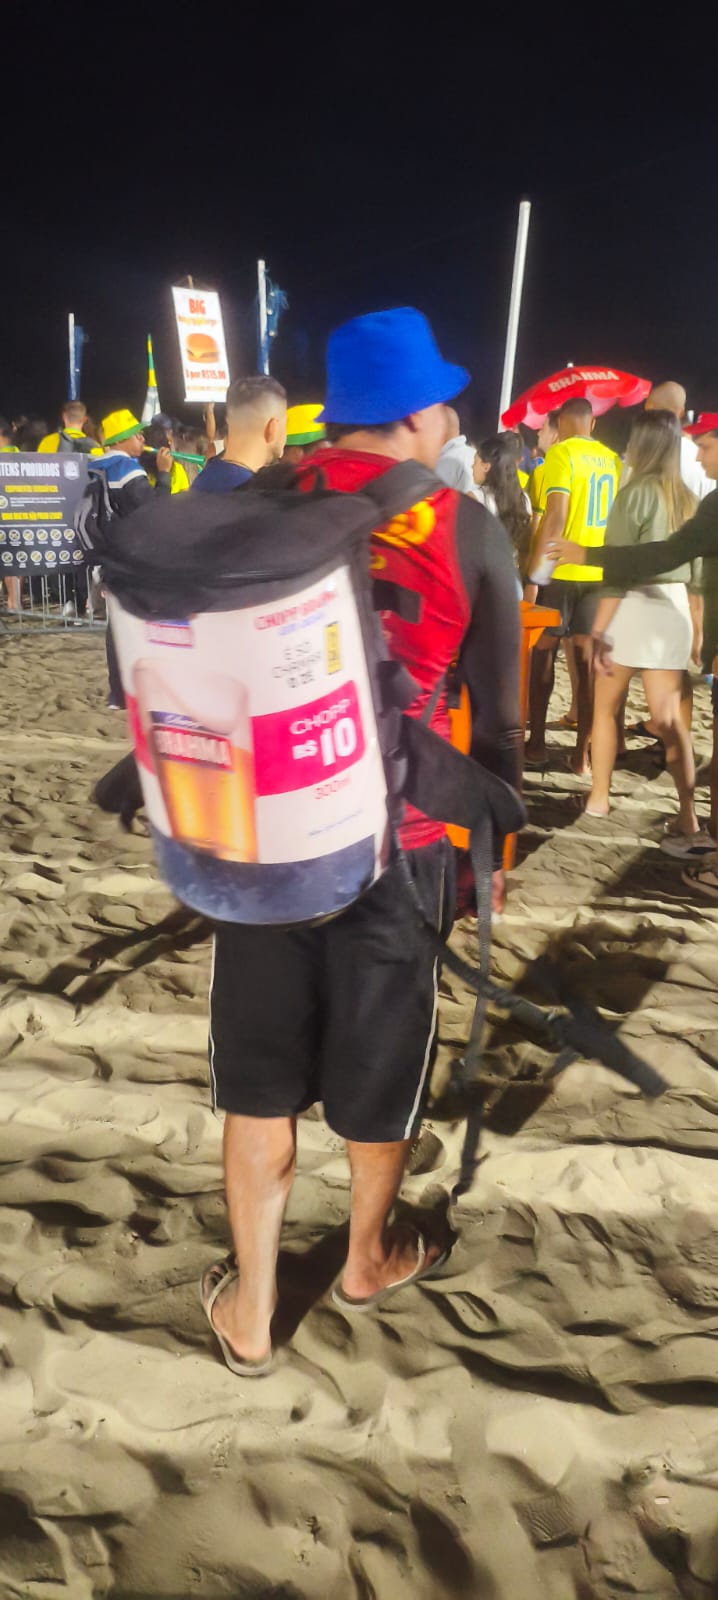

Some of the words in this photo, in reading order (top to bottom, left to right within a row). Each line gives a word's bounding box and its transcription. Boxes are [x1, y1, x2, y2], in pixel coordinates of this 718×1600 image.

[189, 298, 206, 315] BIG
[548, 370, 619, 392] BRAHMA
[587, 472, 614, 527] 10
[289, 699, 351, 734] CHOPP
[153, 729, 231, 765] BRAHMA
[320, 717, 357, 766] 10
